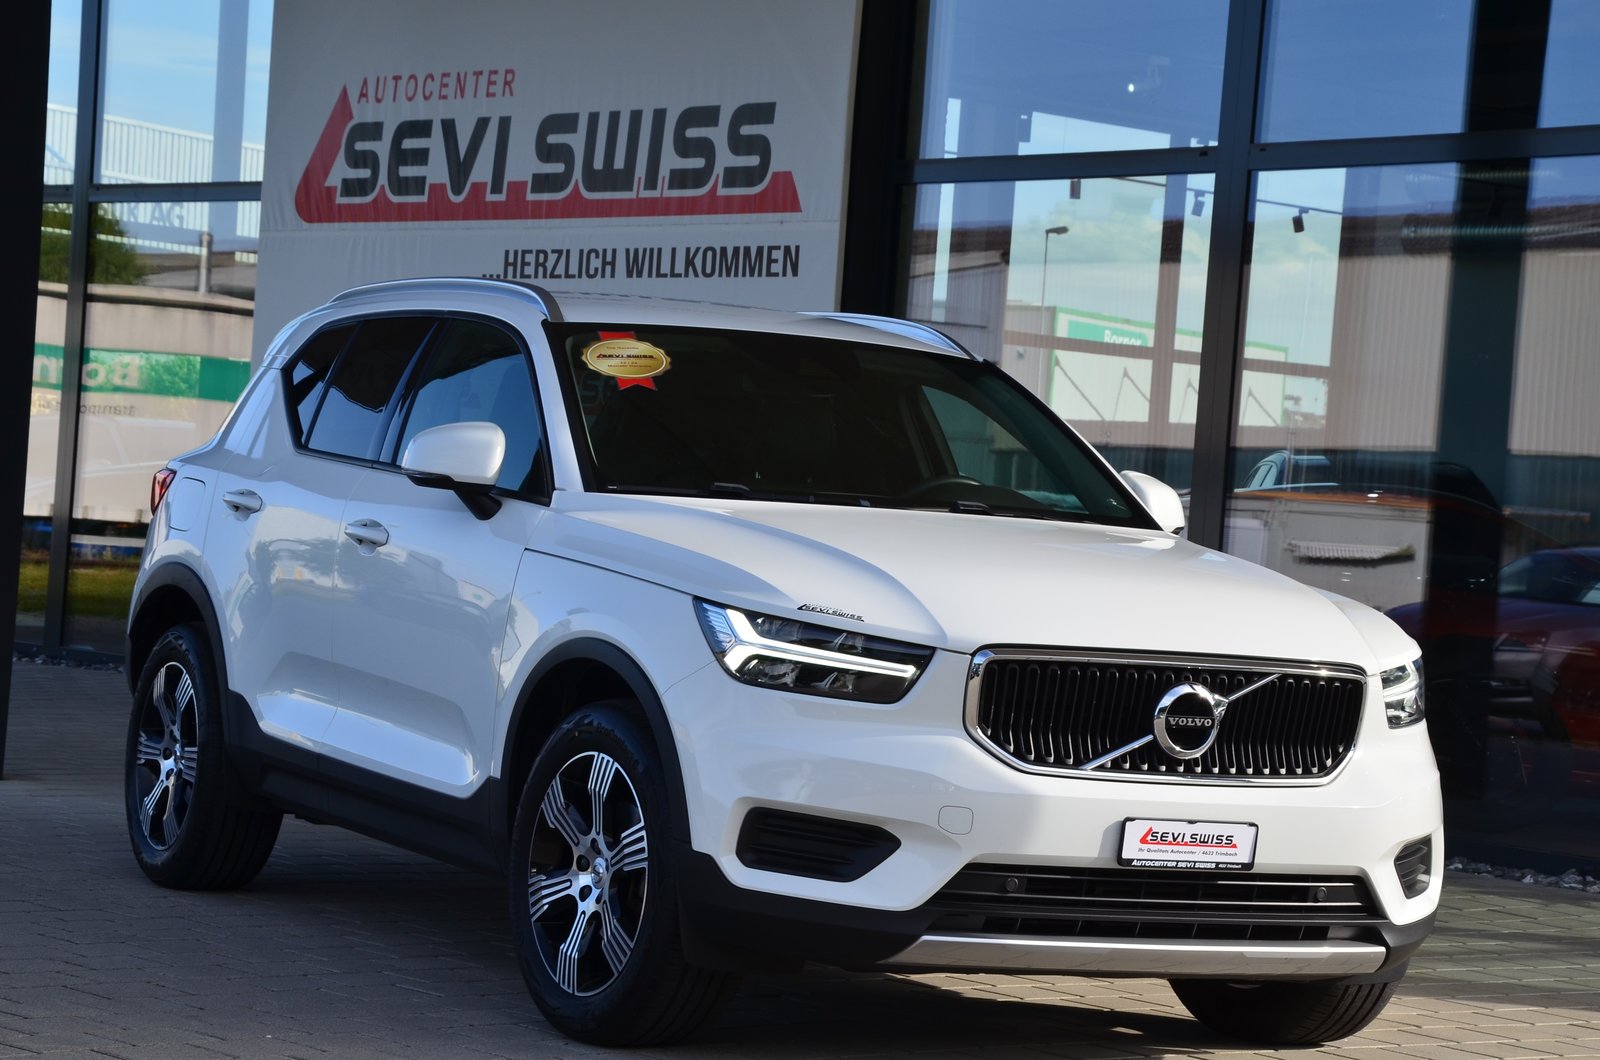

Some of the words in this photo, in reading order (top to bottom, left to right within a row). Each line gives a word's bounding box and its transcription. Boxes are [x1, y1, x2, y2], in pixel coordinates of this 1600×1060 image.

[357, 68, 516, 104] AUTOCENTER
[339, 115, 512, 198] SEVI
[529, 101, 777, 194] SWISS
[625, 244, 800, 278] WILLKOMMEN
[1168, 717, 1212, 727] VOLVO
[1149, 831, 1186, 843] SEVI
[1188, 833, 1234, 845] SWISS
